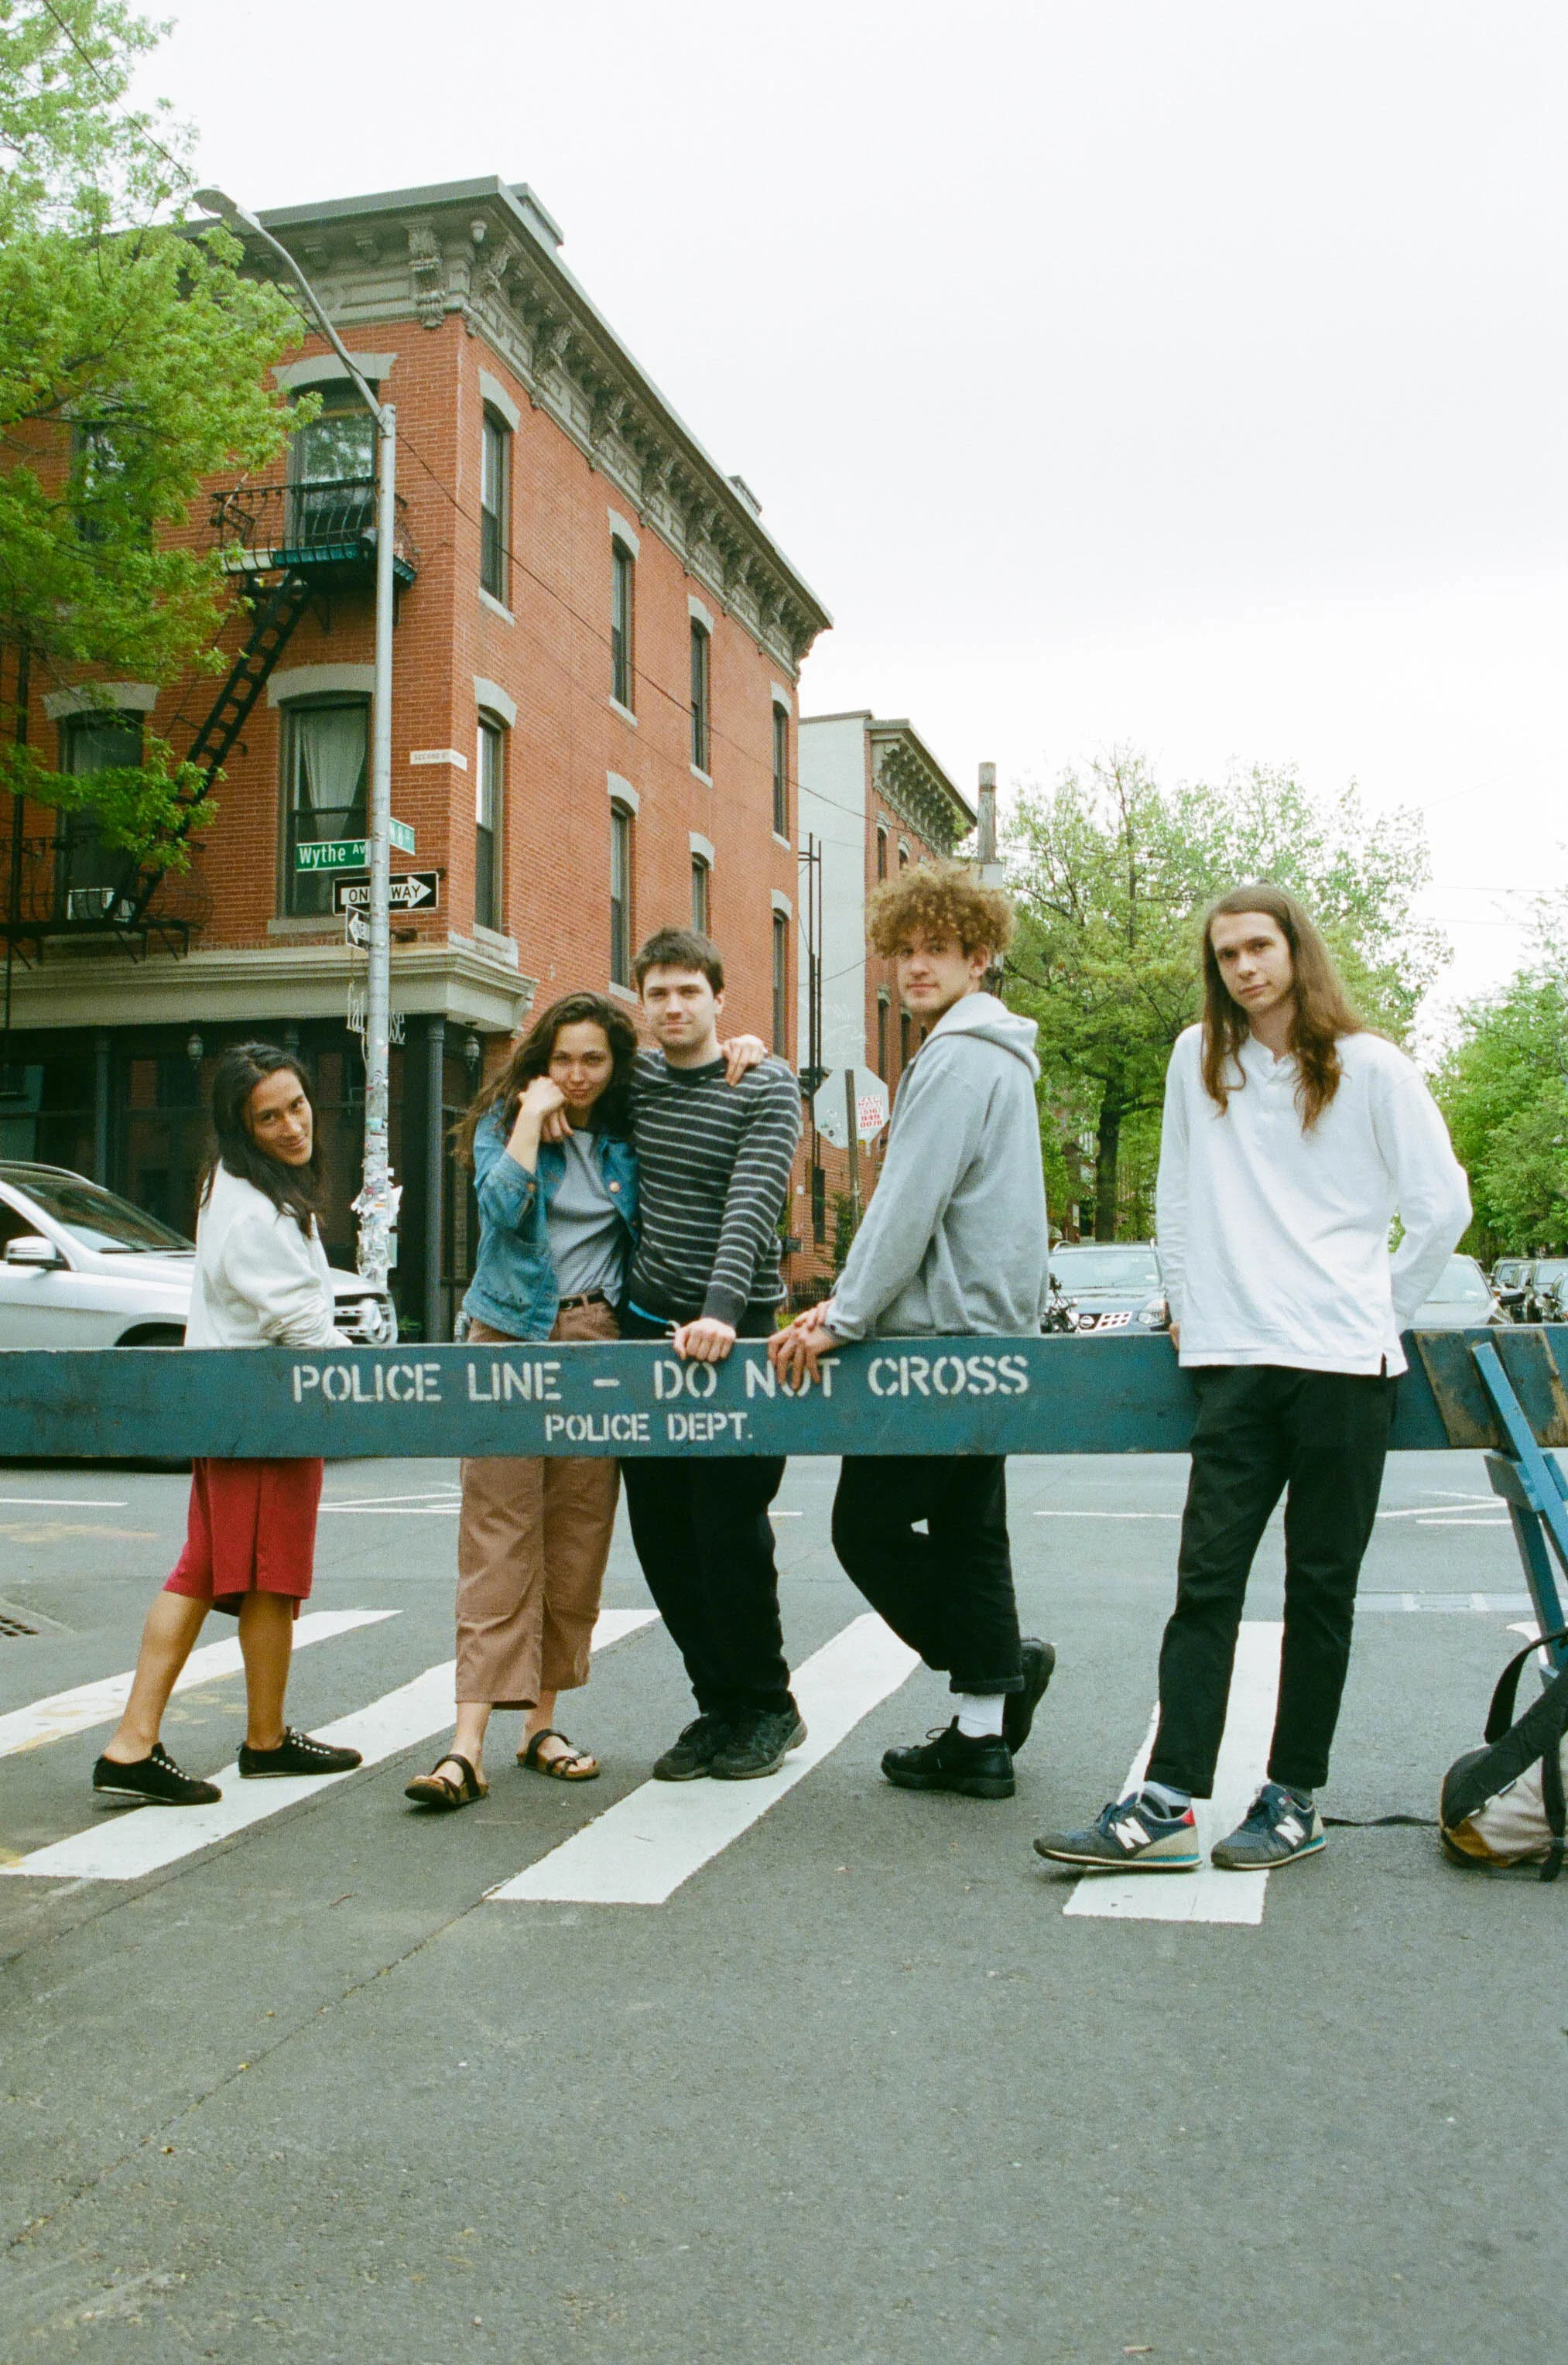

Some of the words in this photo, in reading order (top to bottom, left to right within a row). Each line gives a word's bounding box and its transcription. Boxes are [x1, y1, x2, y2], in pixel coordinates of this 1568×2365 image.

[299, 844, 346, 868] Wythe
[348, 888, 368, 902] ON
[391, 885, 420, 899] WAY
[293, 1363, 442, 1402] POLICE
[467, 1361, 562, 1401] LINE
[654, 1359, 717, 1399] DO
[868, 1356, 1029, 1396] CROSS
[545, 1414, 650, 1442] POLICE
[668, 1412, 753, 1441] DEPT.
